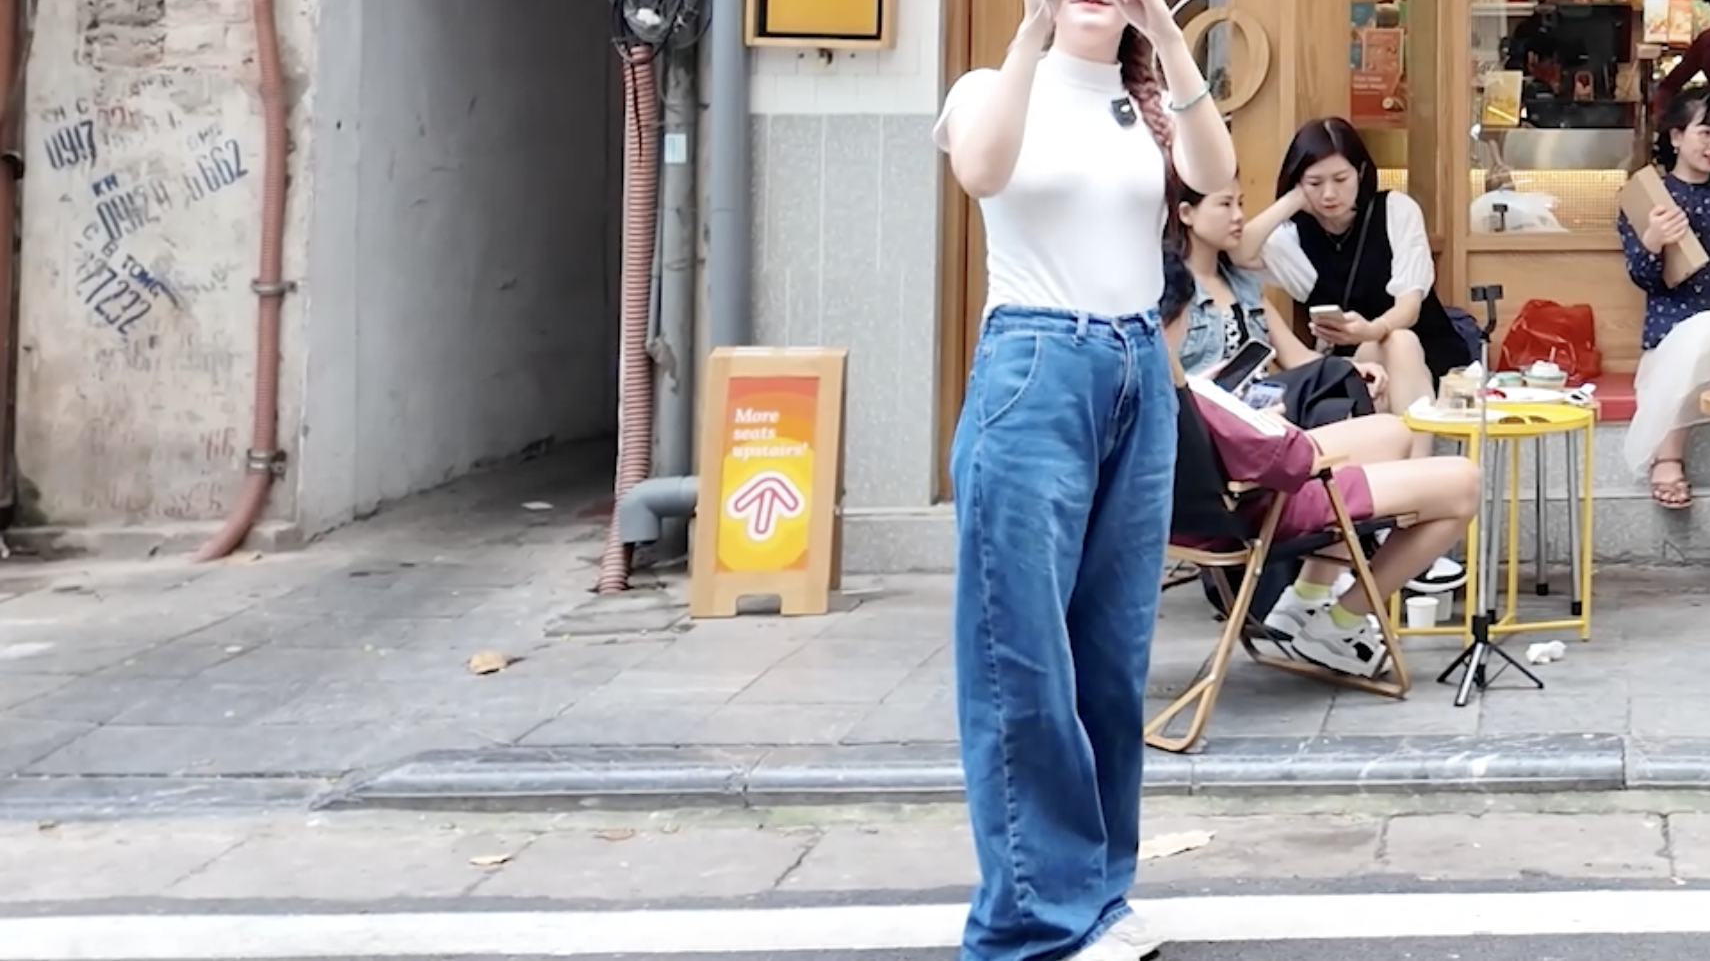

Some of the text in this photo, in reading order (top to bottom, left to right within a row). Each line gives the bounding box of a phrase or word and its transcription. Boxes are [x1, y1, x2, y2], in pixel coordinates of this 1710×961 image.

[735, 407, 780, 424] More
[733, 427, 776, 441] seats
[732, 441, 809, 463] upstairs!
